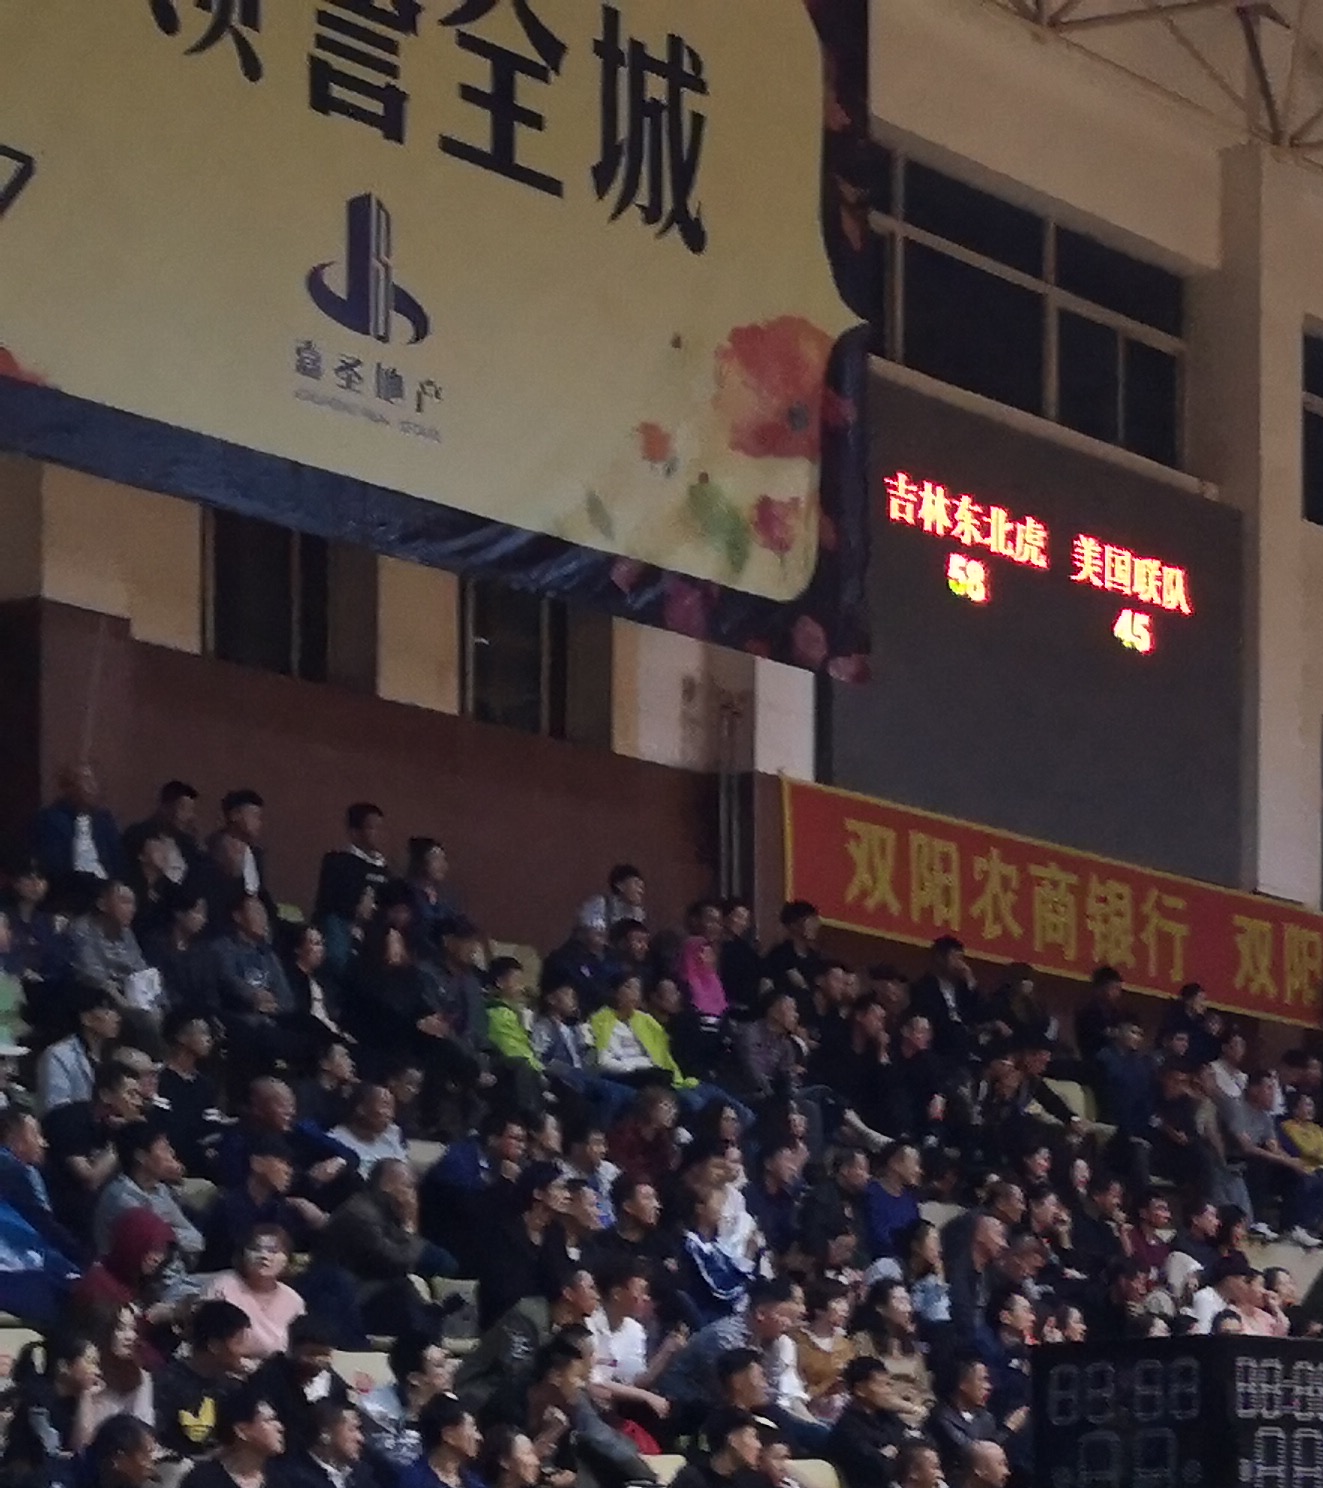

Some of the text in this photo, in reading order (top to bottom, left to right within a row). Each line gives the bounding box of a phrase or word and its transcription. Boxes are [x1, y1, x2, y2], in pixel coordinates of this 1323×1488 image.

[884, 471, 1193, 616] 吉林东北虎 美国联队
[1113, 608, 1155, 654] 45
[844, 818, 1191, 982] 双阳农商银行
